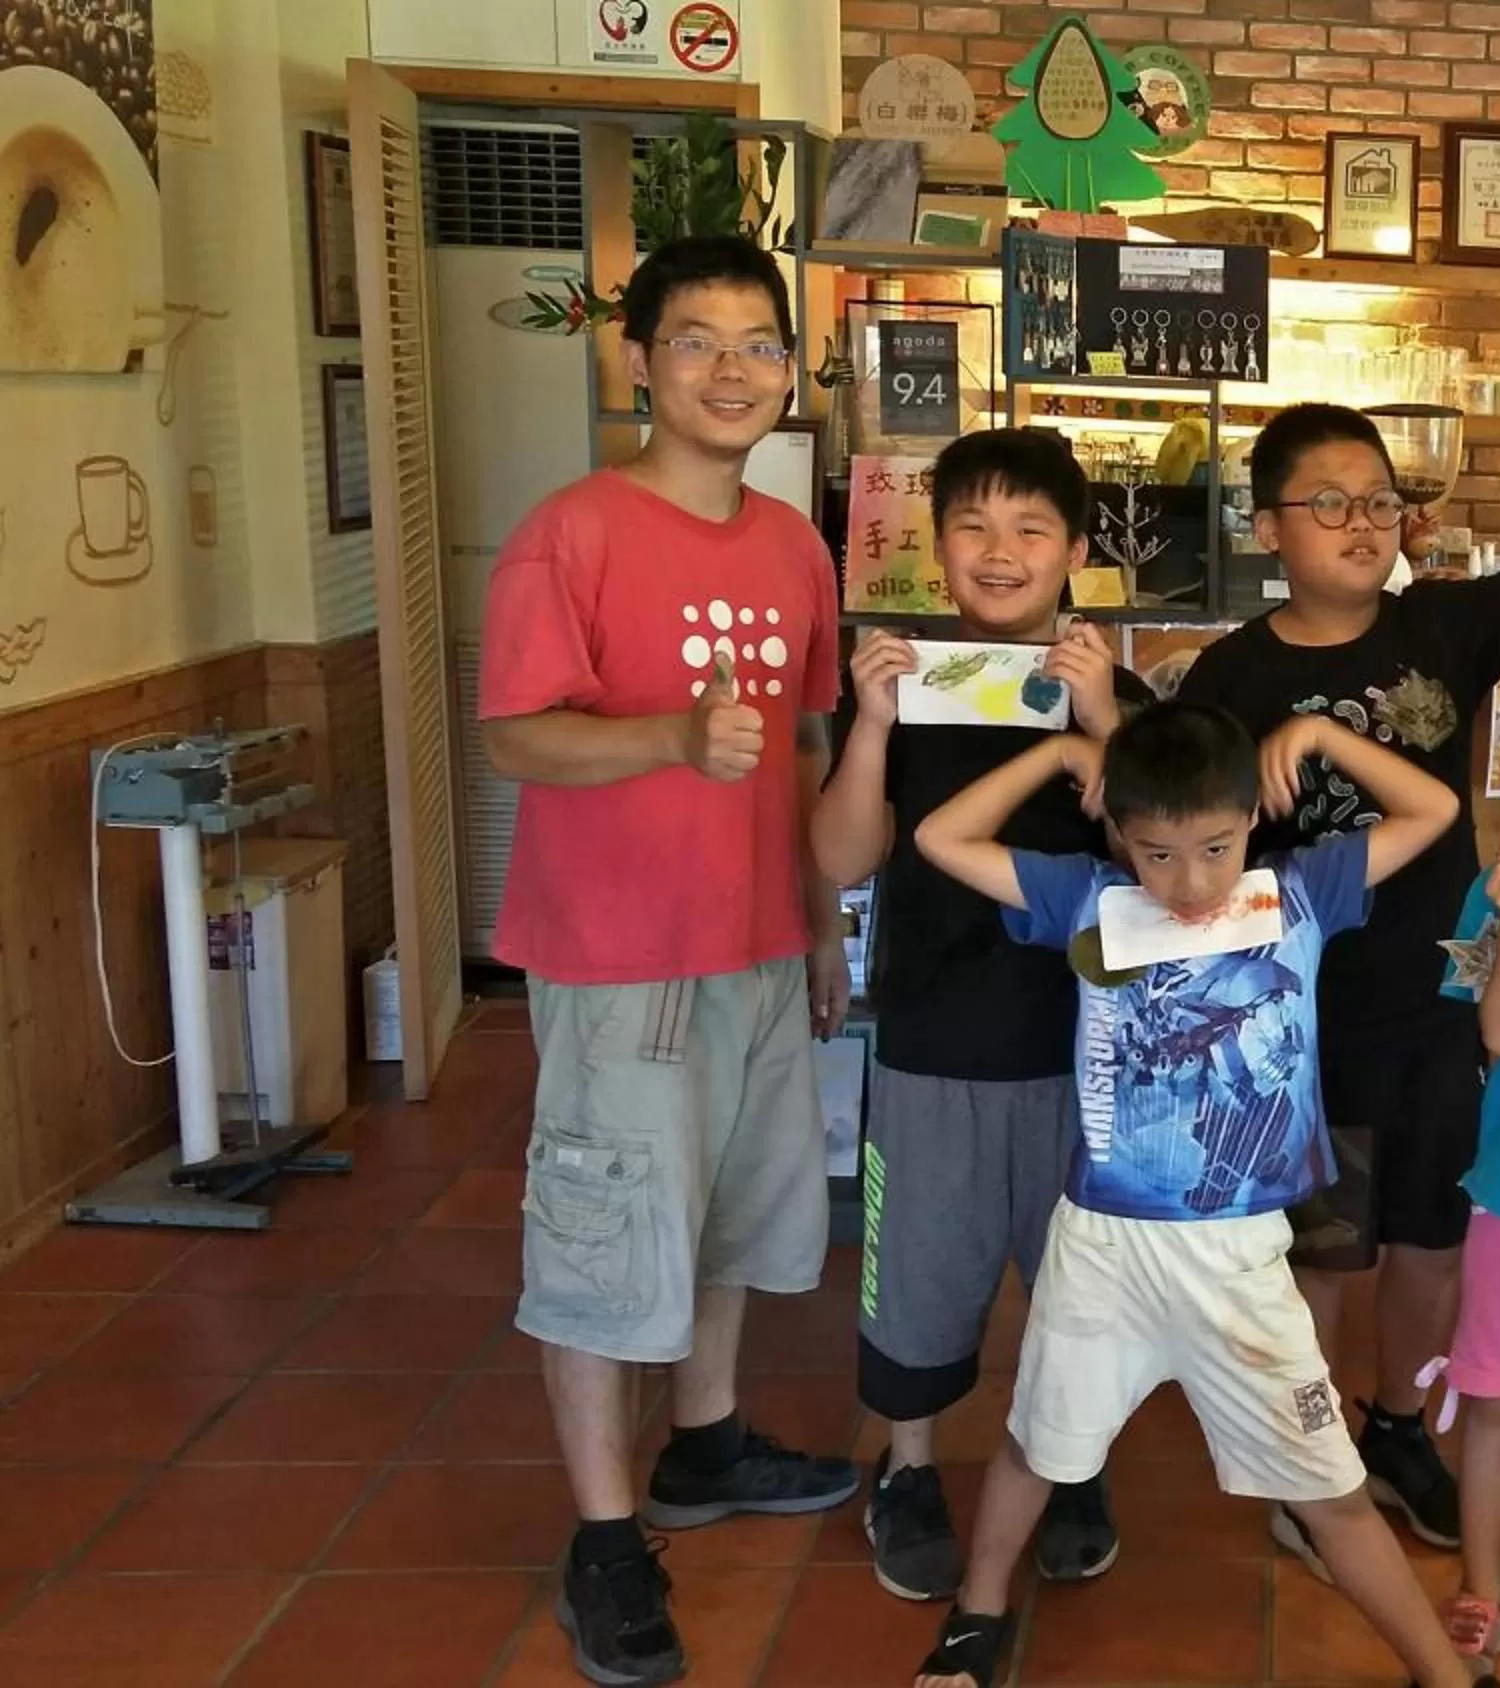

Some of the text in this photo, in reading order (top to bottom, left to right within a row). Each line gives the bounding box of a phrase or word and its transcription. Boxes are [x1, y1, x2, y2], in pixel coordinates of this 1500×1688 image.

[891, 334, 946, 349] agoda
[892, 372, 947, 405] 9.4
[864, 520, 921, 559] 手工
